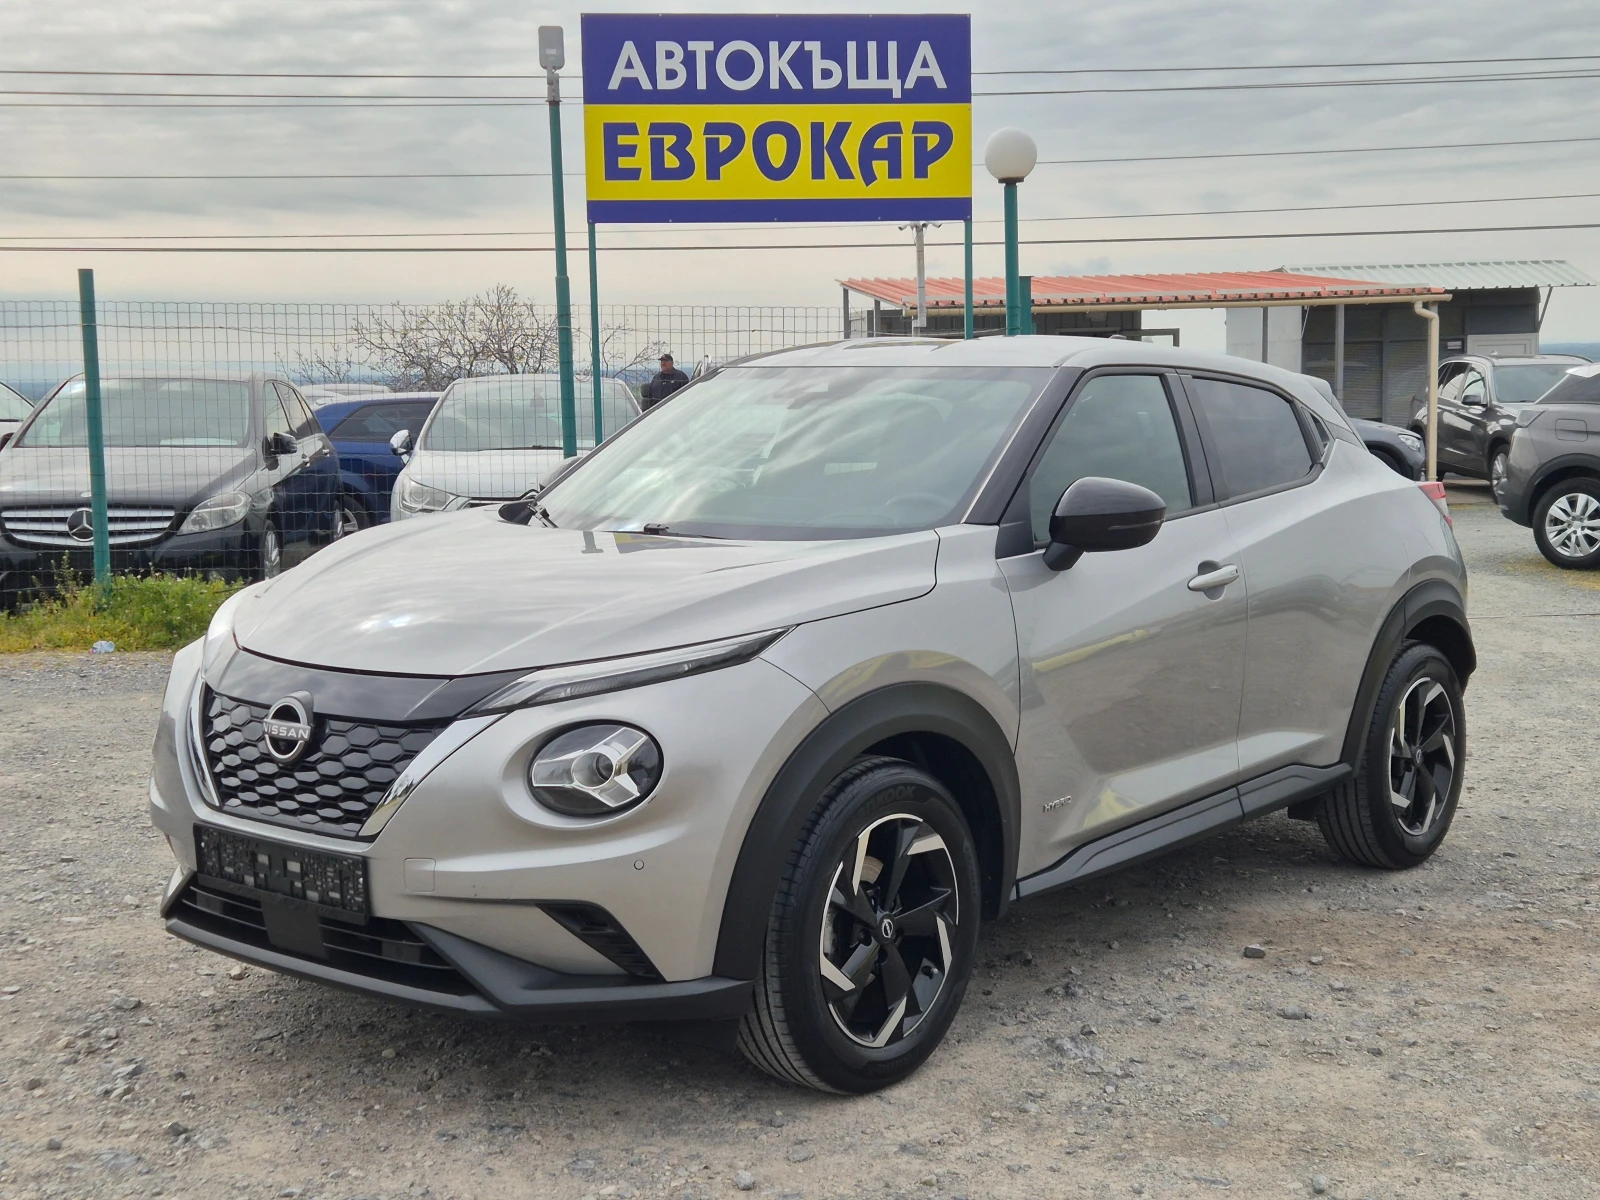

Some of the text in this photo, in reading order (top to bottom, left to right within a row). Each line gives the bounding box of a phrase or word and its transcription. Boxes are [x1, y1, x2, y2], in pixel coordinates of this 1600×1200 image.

[607, 40, 948, 99] АВТОКЪЩА
[602, 120, 955, 188] ЕВРОКАР
[263, 722, 309, 739] NISSAN
[1043, 795, 1072, 813] HYBRID
